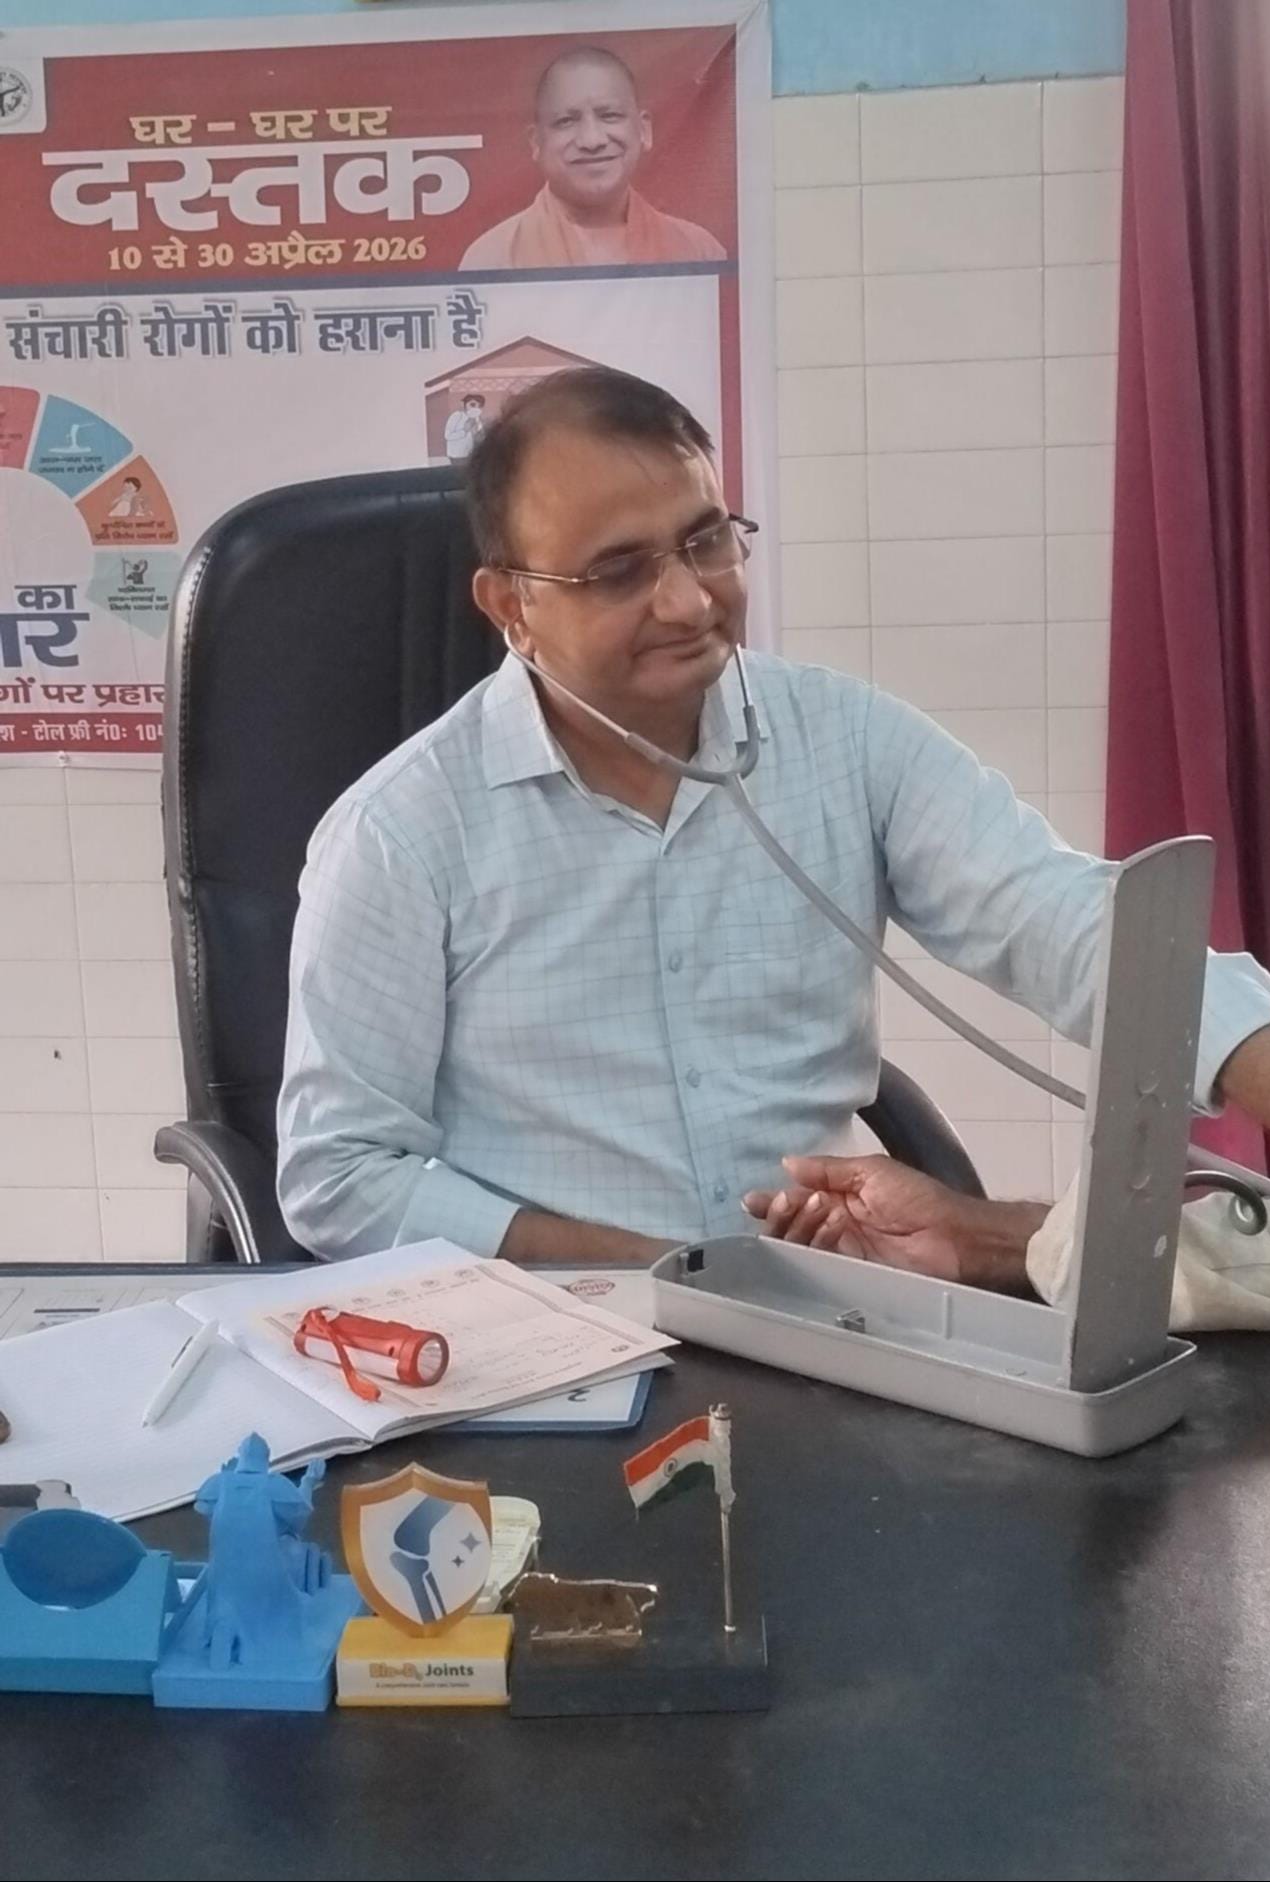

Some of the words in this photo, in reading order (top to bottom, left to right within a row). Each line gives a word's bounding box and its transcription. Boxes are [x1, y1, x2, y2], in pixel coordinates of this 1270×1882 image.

[129, 114, 197, 144] घर
[250, 109, 318, 140] घर
[326, 106, 393, 137] पर
[42, 134, 483, 231] दस्तक
[108, 246, 142, 270] 10
[151, 235, 188, 269] से
[198, 243, 234, 268] 30
[244, 230, 346, 270] अप्रैल
[353, 236, 427, 262] 2026
[5, 306, 130, 361] संचारी
[140, 303, 234, 357] रोगों
[241, 301, 301, 355] को
[313, 309, 435, 352] हराना
[446, 293, 483, 349] है
[14, 584, 77, 611] का
[40, 684, 87, 704] पर
[32, 719, 65, 741] टोल
[67, 719, 91, 741] फ्री
[425, 1662, 475, 1678] Joints
